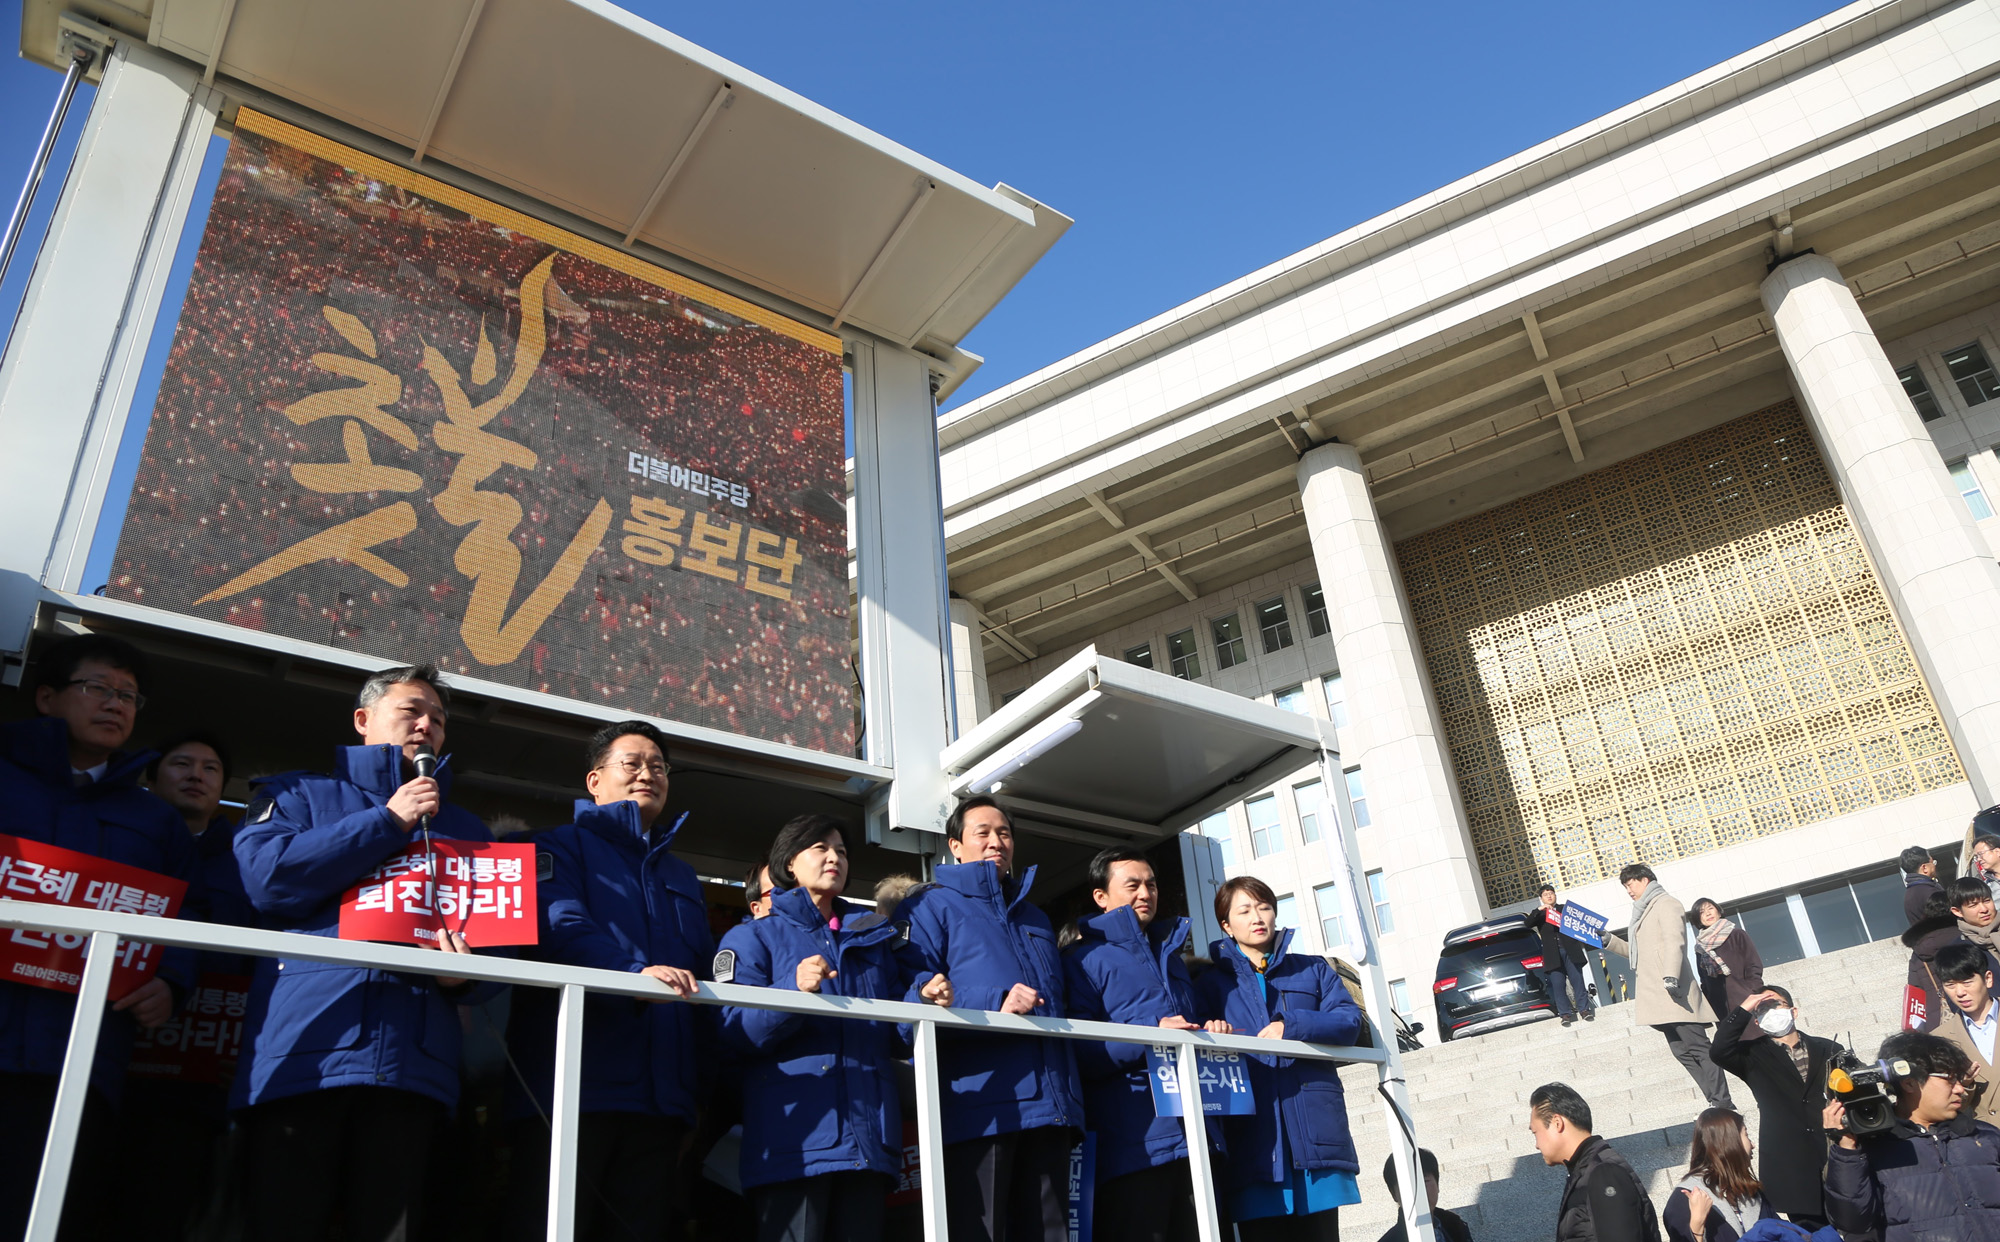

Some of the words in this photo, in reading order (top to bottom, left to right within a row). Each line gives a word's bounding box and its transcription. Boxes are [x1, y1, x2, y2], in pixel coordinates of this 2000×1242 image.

[194, 251, 613, 665] 촛불
[628, 451, 752, 509] 더불어민주당
[621, 494, 803, 601] 홍보단
[445, 856, 523, 883] 대통령
[354, 880, 524, 921] 퇴진하라!
[12, 961, 80, 987] 더불어민주당
[1156, 1065, 1247, 1094] 엄수사!
